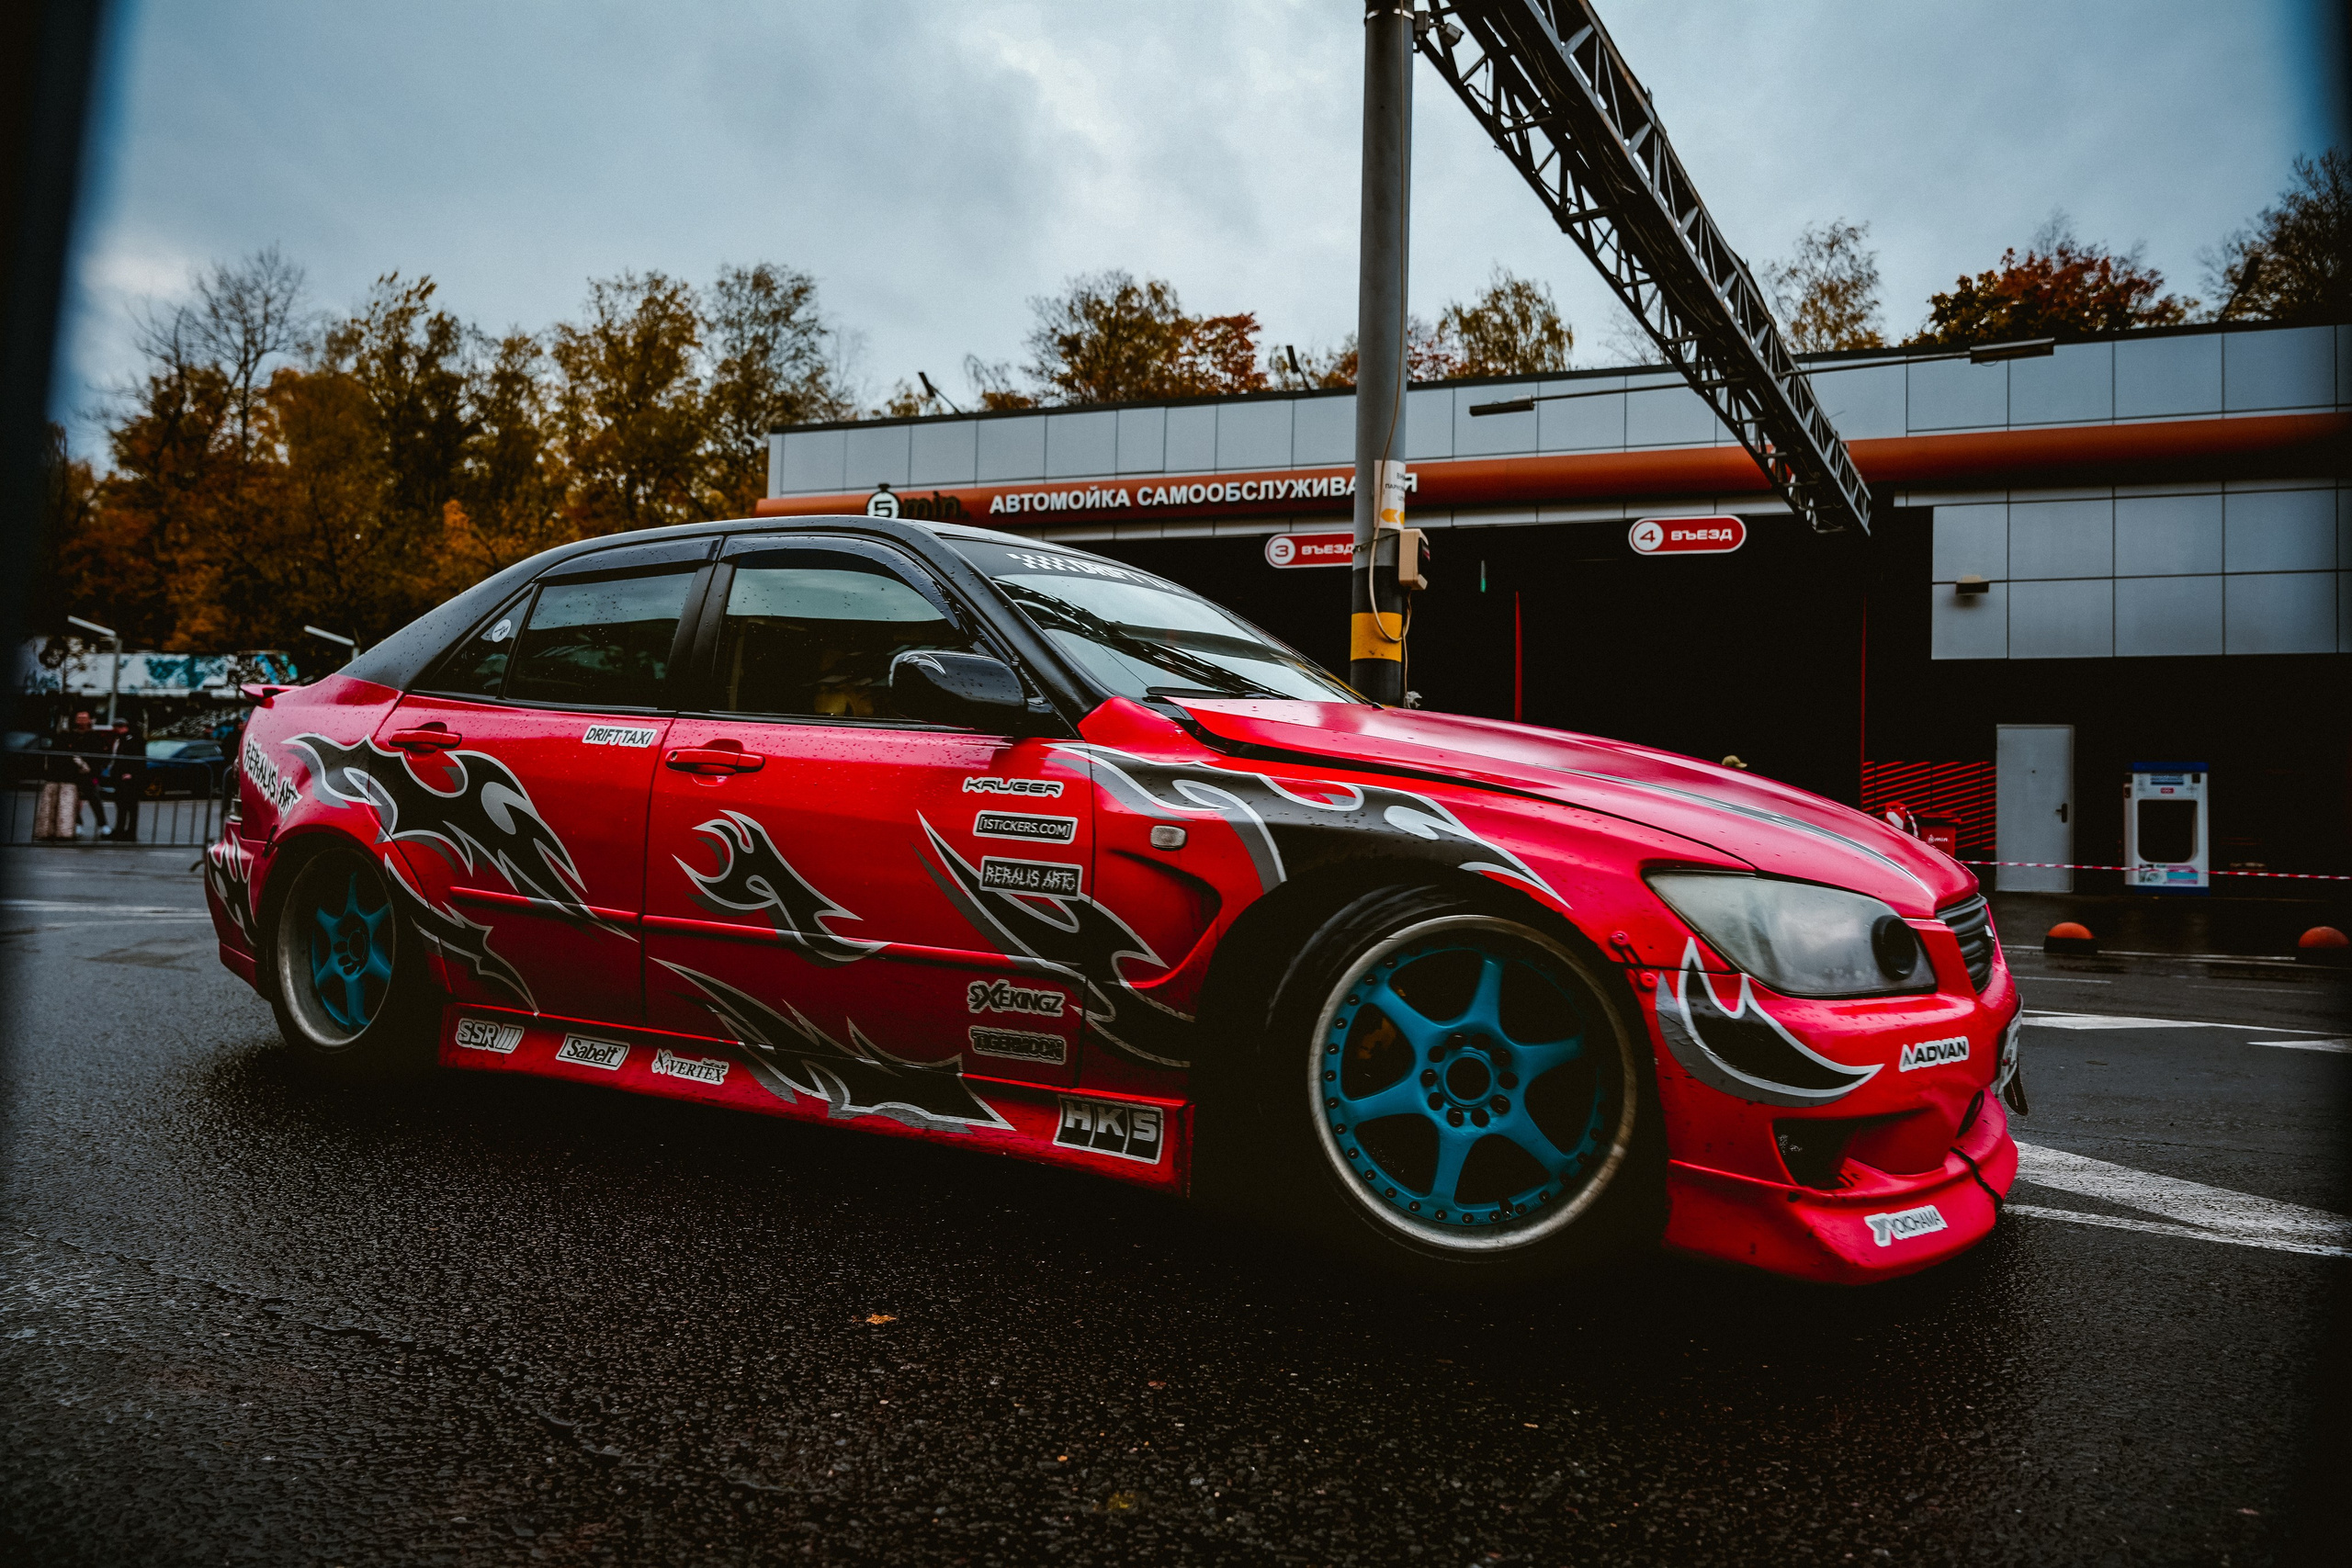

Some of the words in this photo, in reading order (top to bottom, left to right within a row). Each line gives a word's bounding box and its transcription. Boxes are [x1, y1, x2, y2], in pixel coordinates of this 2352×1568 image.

[989, 485, 1131, 514] АВТОМОЙКА
[1136, 472, 1418, 506] САМООБСЛУЖИВАЯ
[1640, 530, 1656, 543] 4
[1275, 545, 1289, 558] 3
[965, 779, 1062, 795] KRUGER
[567, 1039, 620, 1064] Sabelt
[671, 1059, 726, 1082] VERTEX
[1064, 1101, 1158, 1143] HKS
